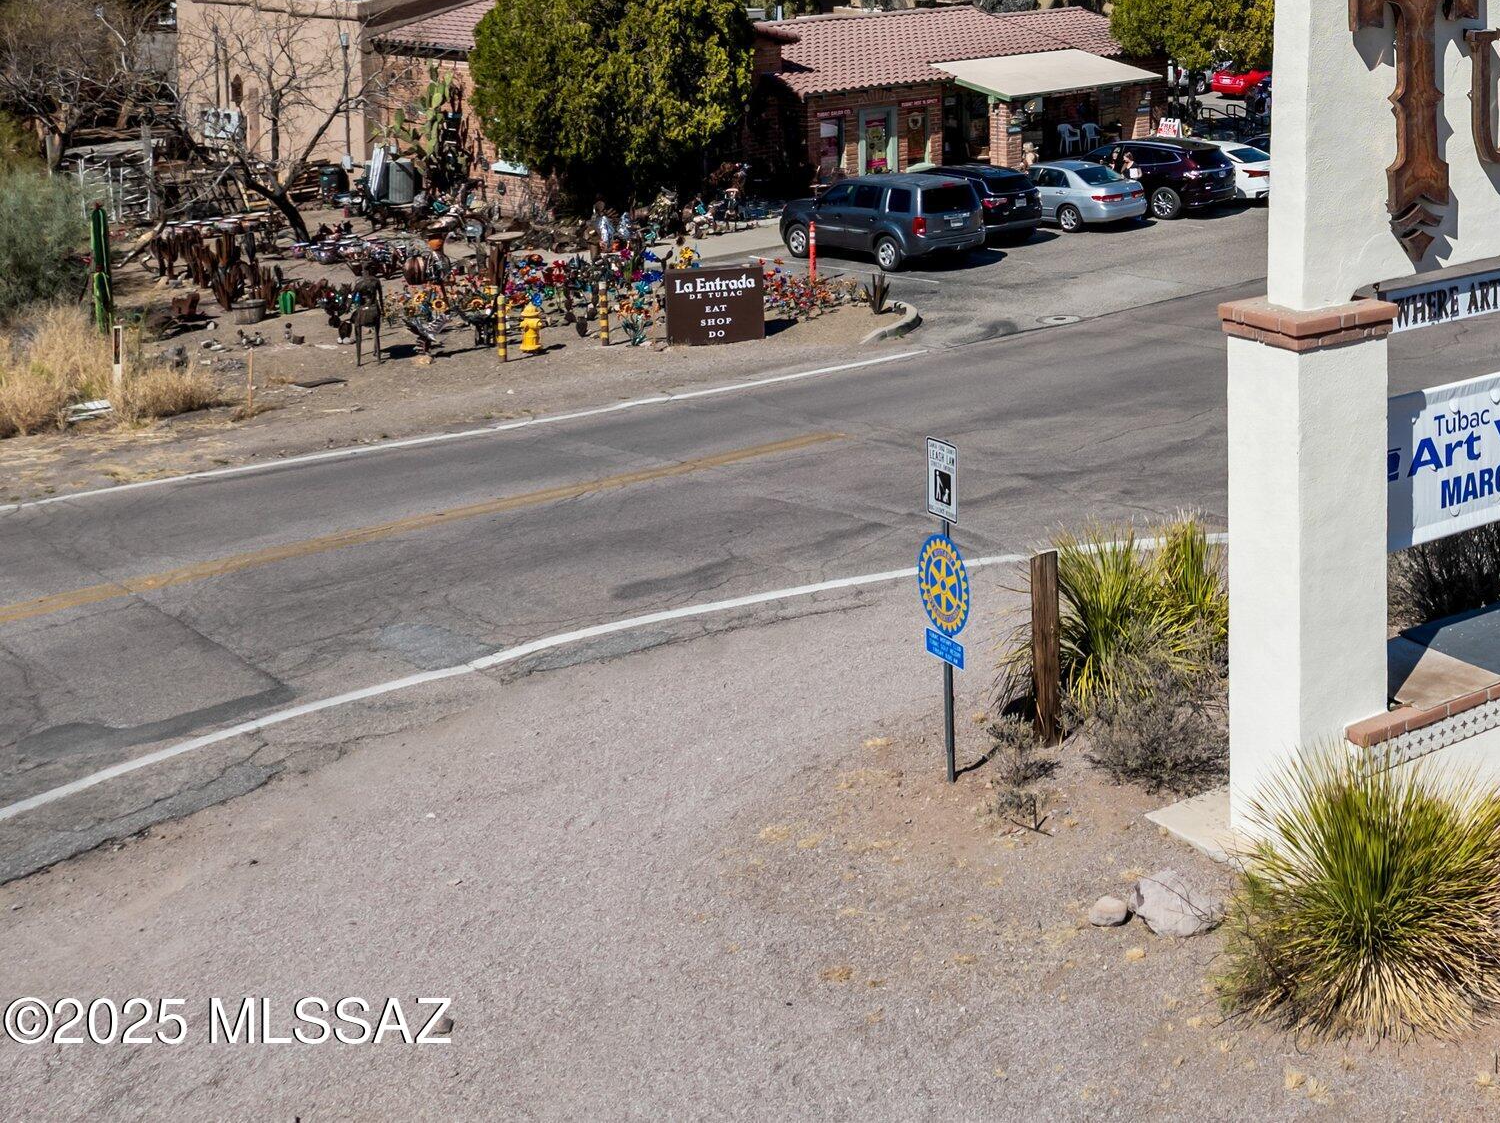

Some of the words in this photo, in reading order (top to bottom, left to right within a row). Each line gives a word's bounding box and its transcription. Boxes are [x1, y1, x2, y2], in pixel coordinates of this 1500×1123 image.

[674, 279, 694, 294] La
[695, 273, 756, 293] Entrada
[689, 292, 703, 300] DE
[708, 290, 743, 299] TUBAC
[705, 304, 728, 313] EAT
[1393, 285, 1459, 329] WHERE
[1466, 279, 1500, 315] ART
[700, 317, 732, 327] SHOP
[708, 330, 725, 338] DO
[1433, 408, 1491, 438] Tubac
[929, 448, 945, 463] LEASH
[1407, 430, 1482, 478] Art
